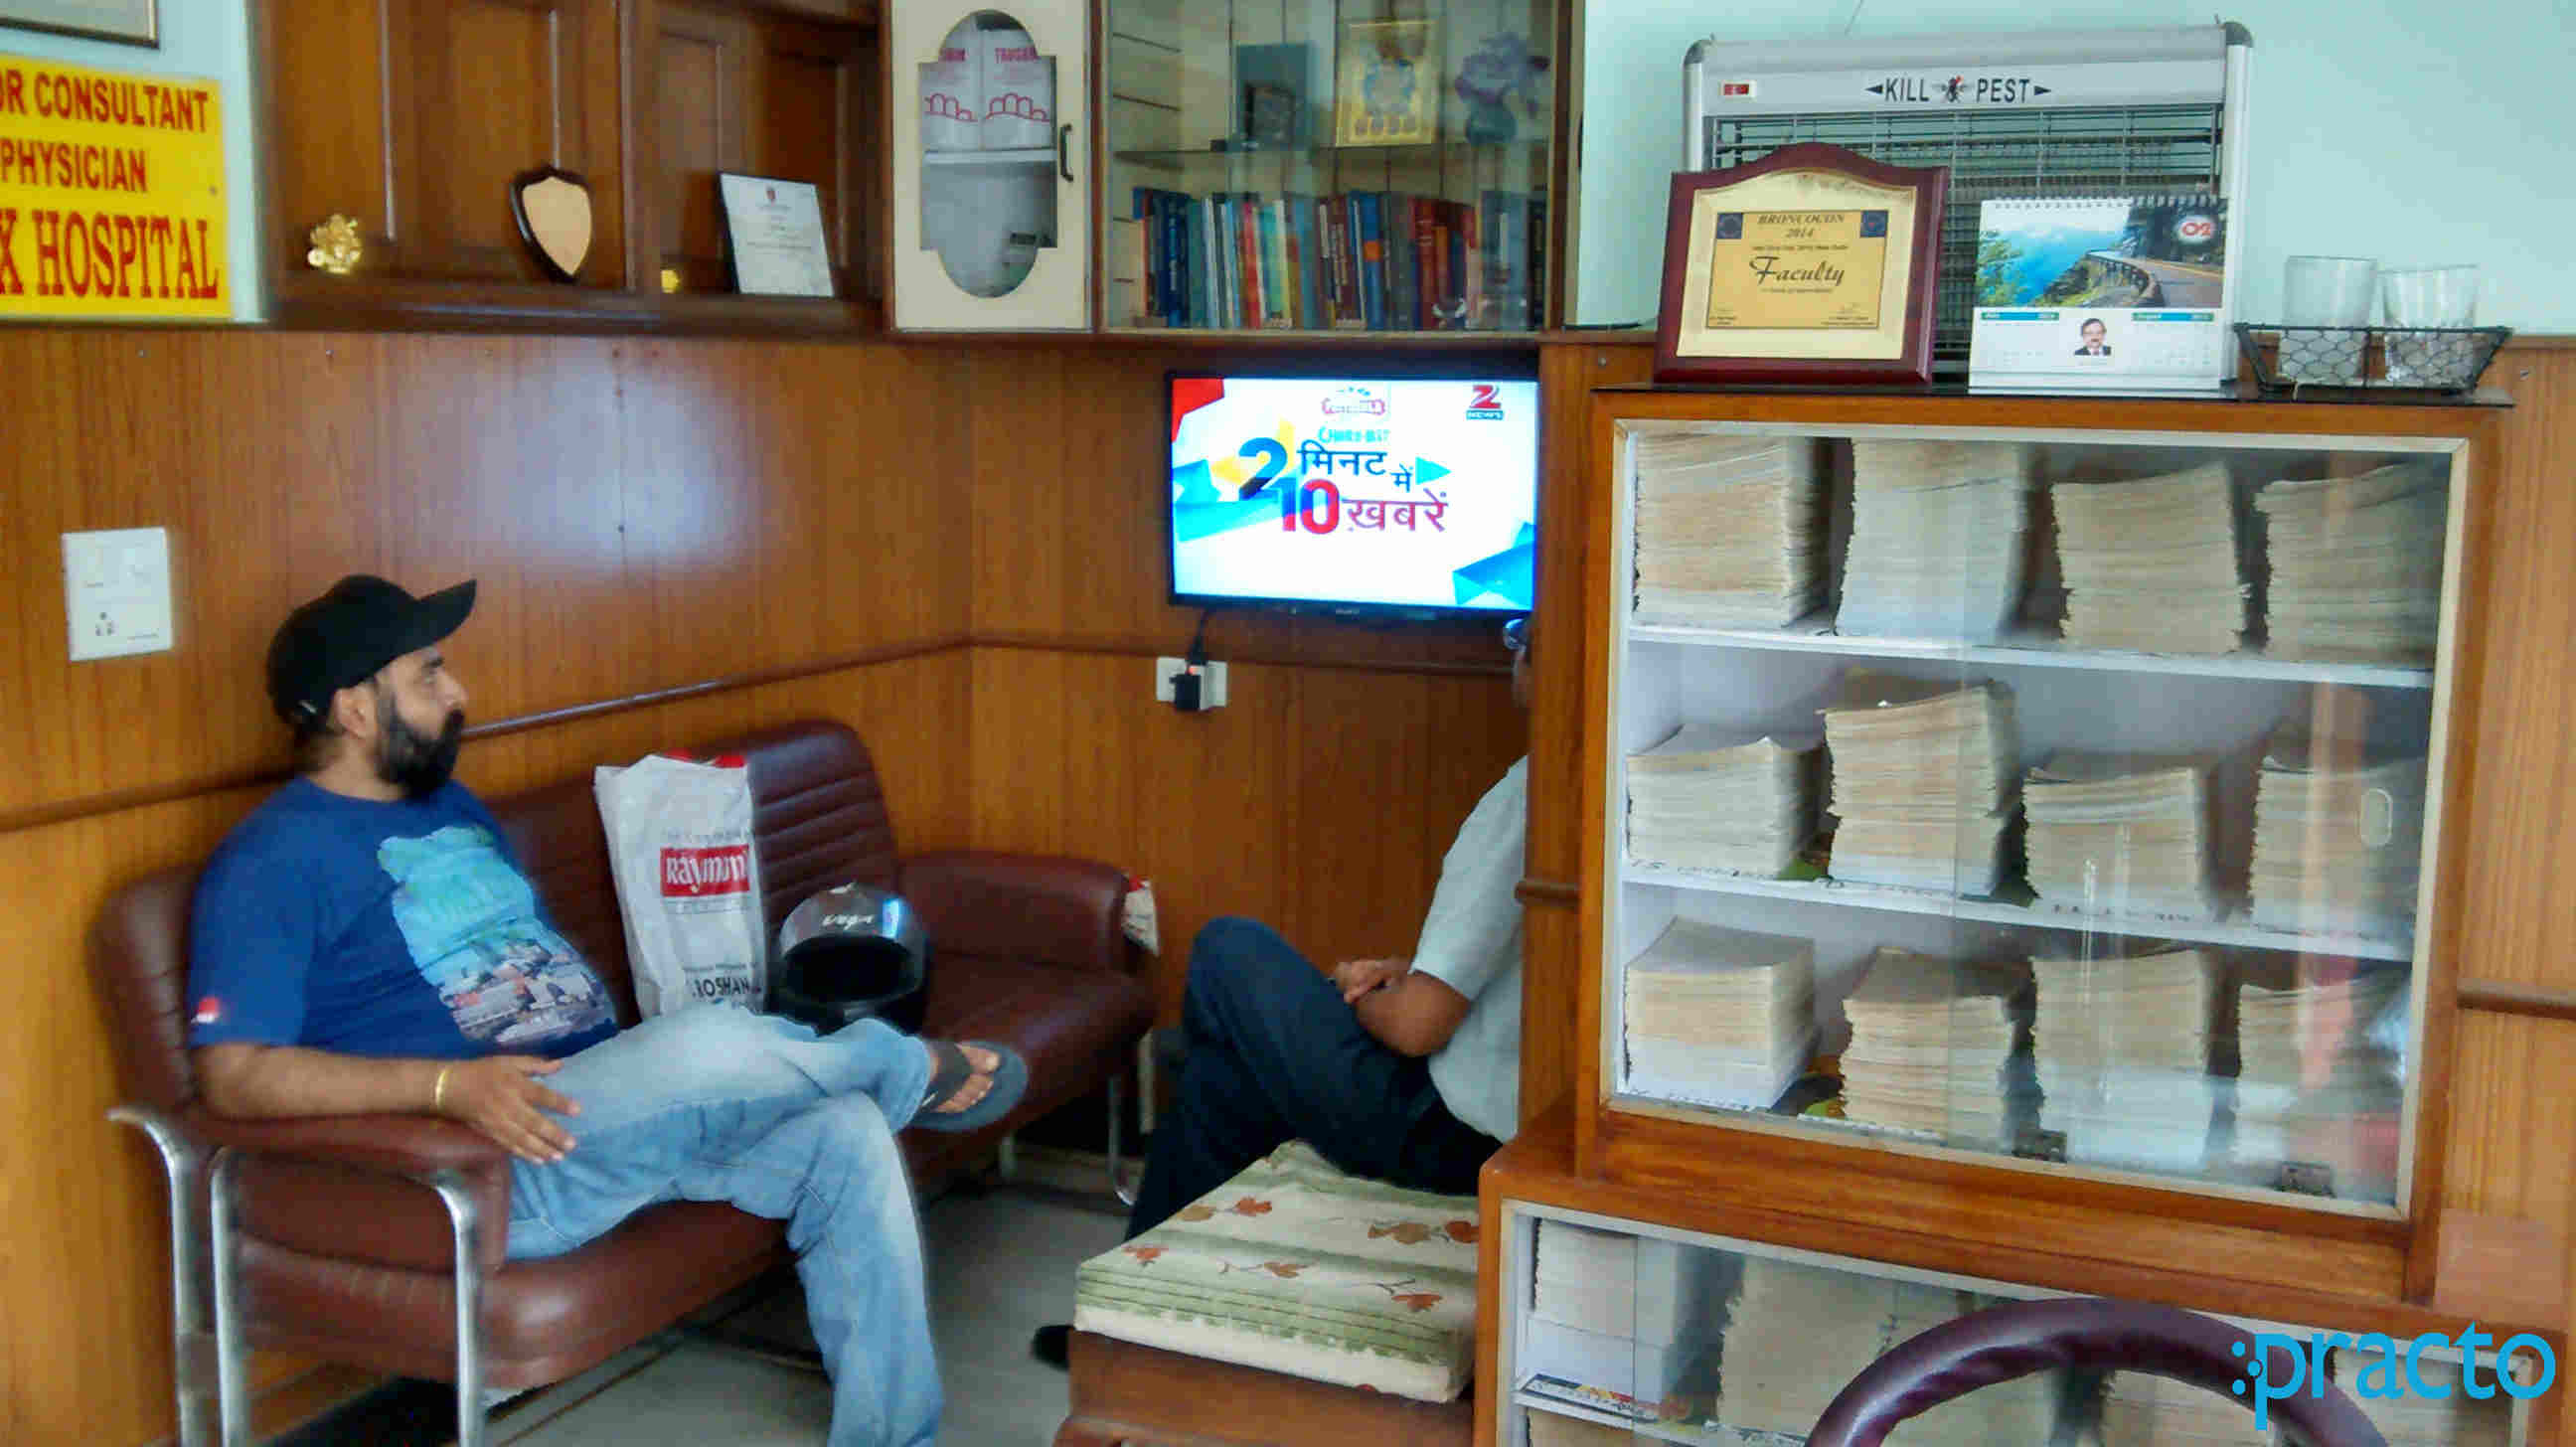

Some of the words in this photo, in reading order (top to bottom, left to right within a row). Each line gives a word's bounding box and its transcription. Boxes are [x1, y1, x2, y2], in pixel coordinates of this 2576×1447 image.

[34, 72, 209, 133] CONSULTANT
[1884, 77, 1931, 102] KILL
[1976, 77, 2030, 102] PEST
[0, 137, 148, 193] PHYSICIAN
[31, 210, 220, 299] HOSPITAL
[1748, 255, 1846, 286] Faculty
[1238, 437, 1288, 502] 2
[1296, 439, 1388, 476] मिनट
[1390, 463, 1414, 493] में
[1280, 477, 1341, 535] 10
